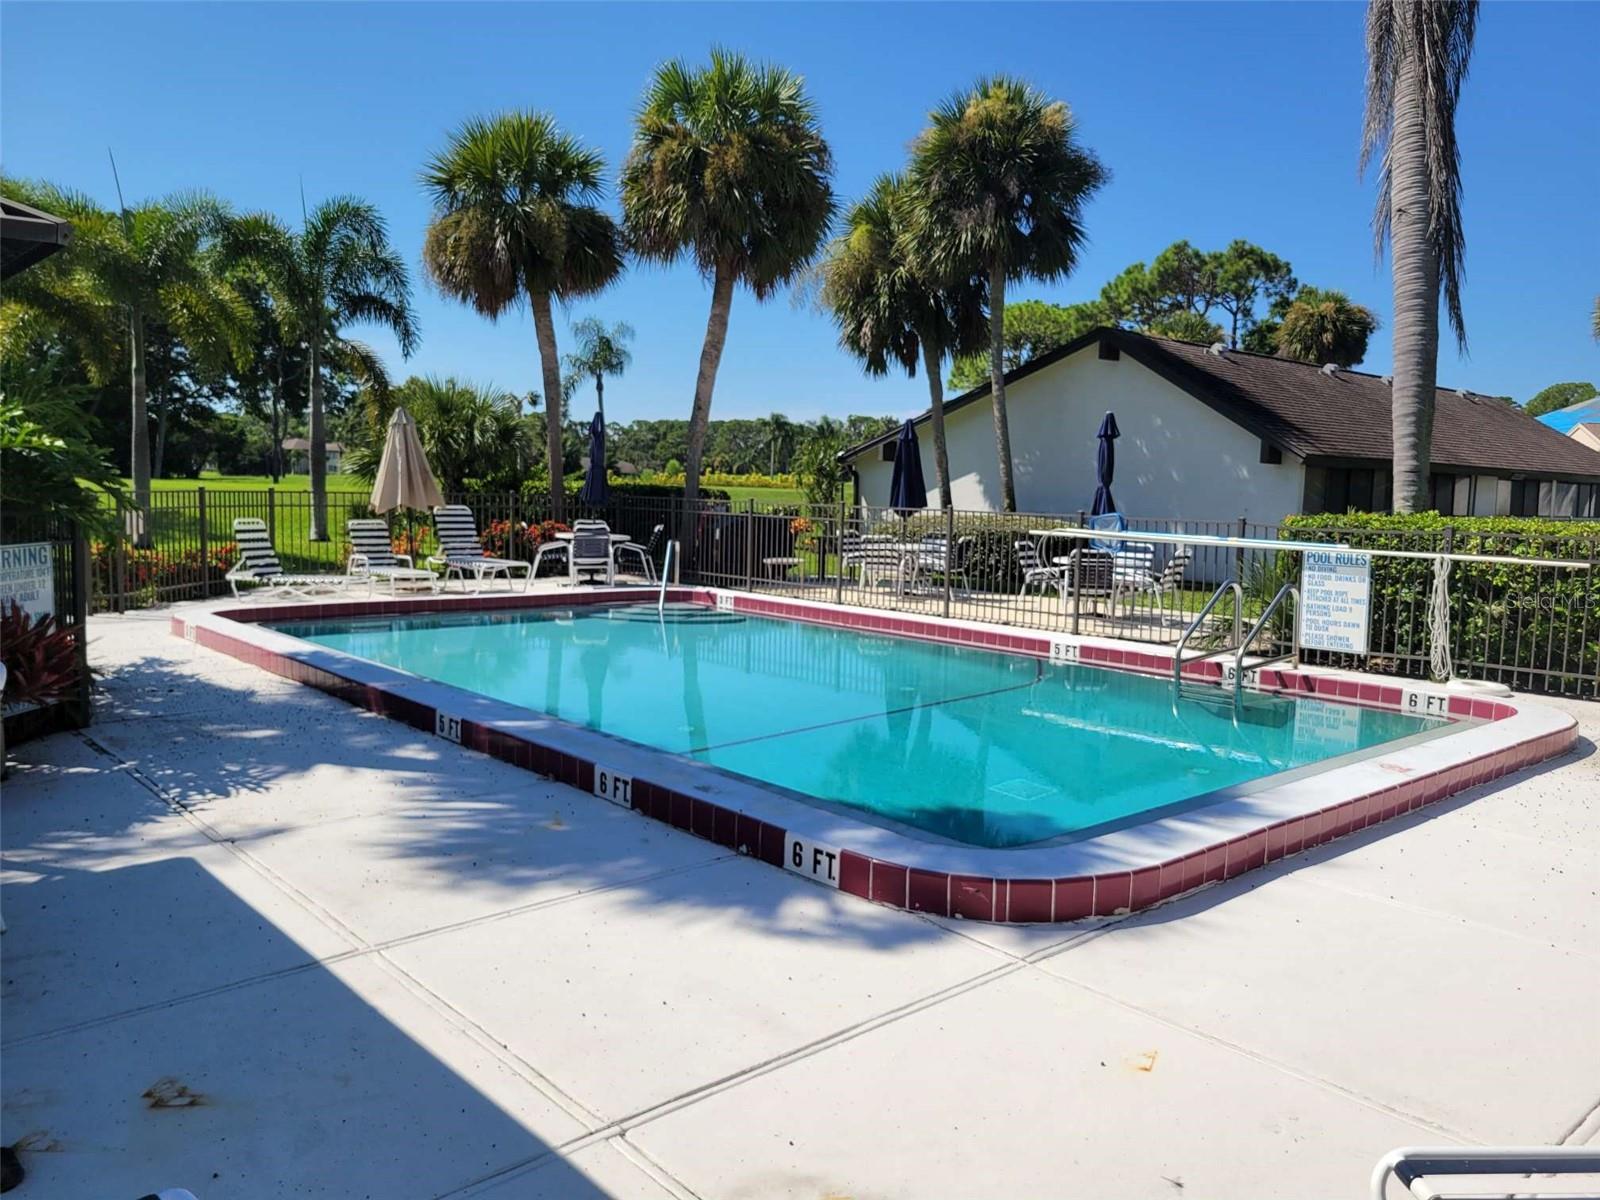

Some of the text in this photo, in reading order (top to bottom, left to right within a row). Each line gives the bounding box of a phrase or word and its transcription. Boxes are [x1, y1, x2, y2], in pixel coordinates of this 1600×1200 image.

[1307, 551, 1367, 566] POOL RULES
[1054, 644, 1060, 655] 5
[1228, 667, 1236, 680] 6
[1409, 693, 1418, 707] 6
[440, 714, 445, 733] 5
[600, 771, 608, 794] 6
[792, 841, 837, 881] 6 FT.
